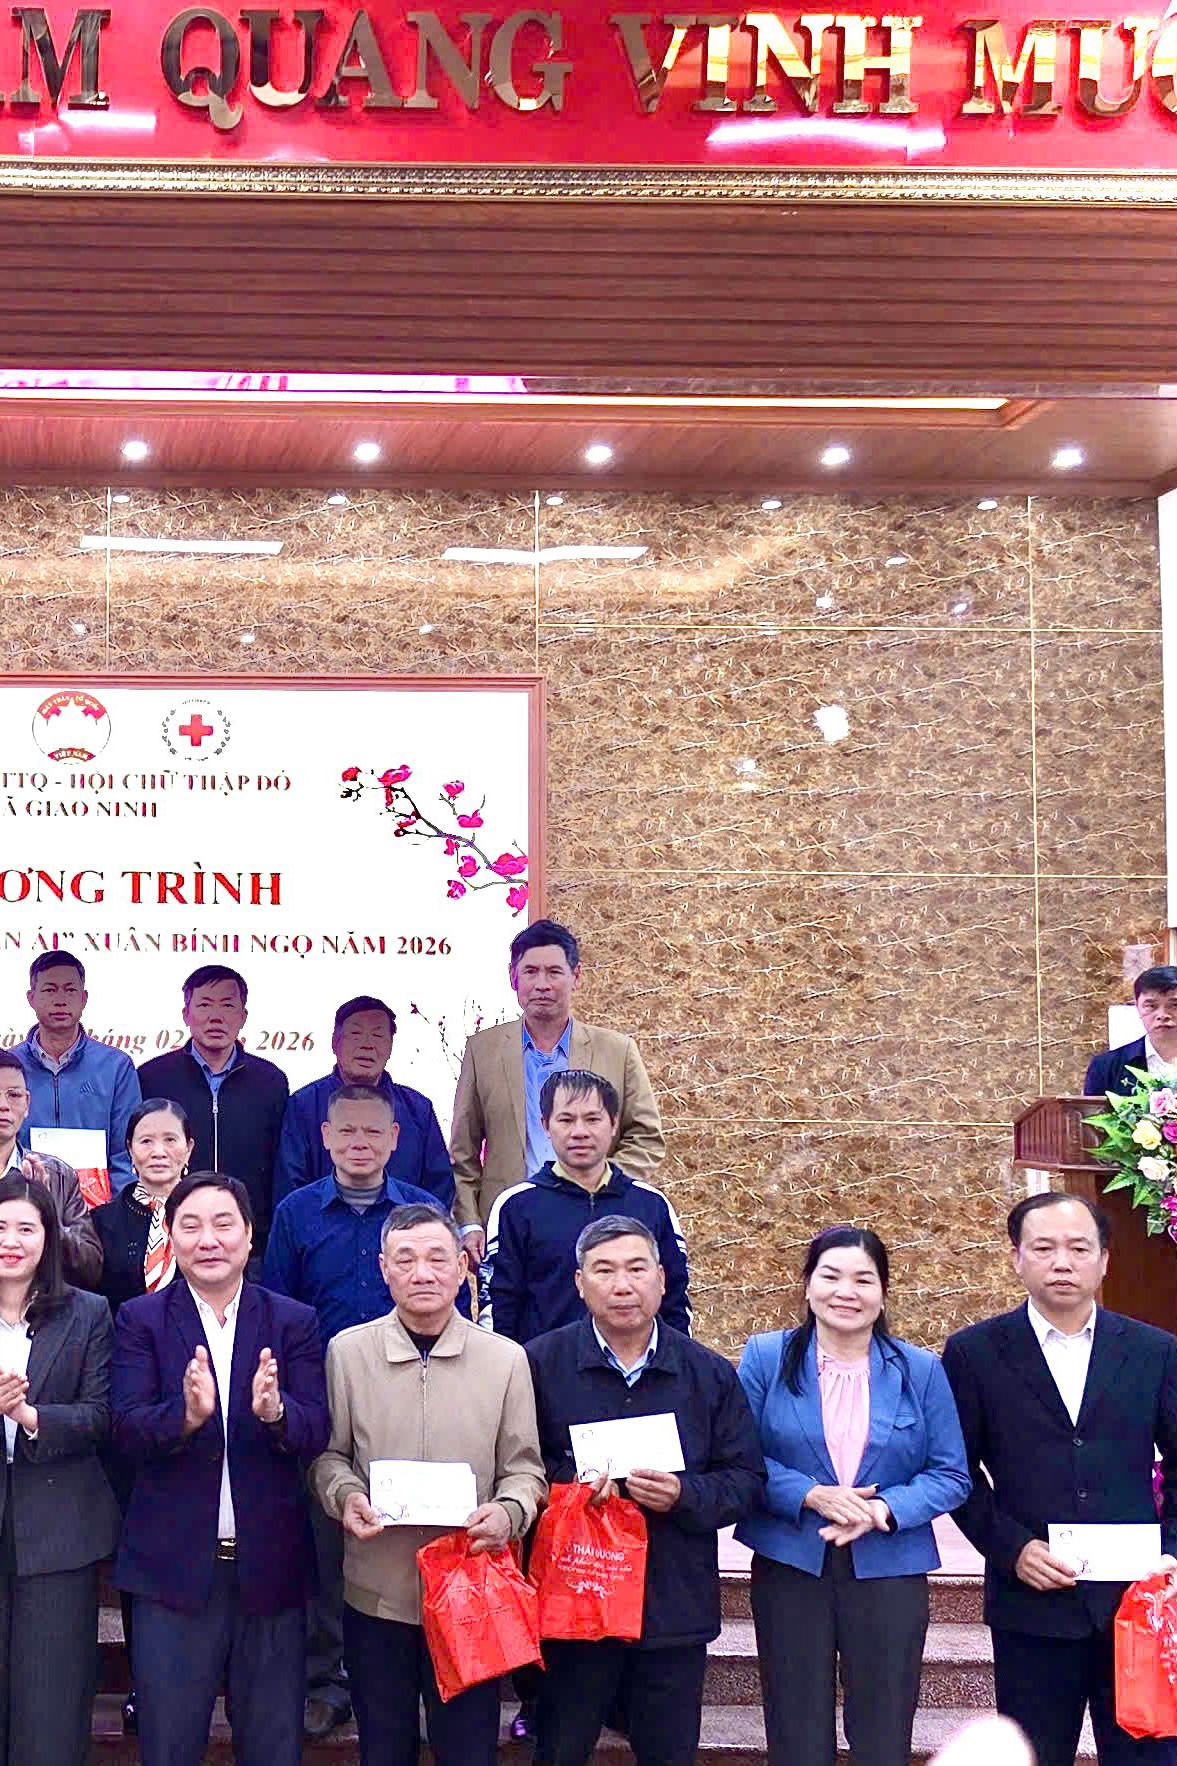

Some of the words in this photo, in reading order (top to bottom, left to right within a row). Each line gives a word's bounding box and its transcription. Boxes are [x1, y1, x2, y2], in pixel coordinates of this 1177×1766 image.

[159, 8, 572, 129] QUANG
[608, 12, 922, 114] VINH
[26, 800, 88, 816] GIAO
[97, 802, 157, 818] NINH
[121, 861, 282, 905] TRÌNH
[84, 927, 160, 951] XUÂN
[172, 928, 239, 952] BÍNH
[322, 931, 385, 954] NĂM
[397, 936, 451, 955] 2026
[255, 1030, 315, 1051] 2026
